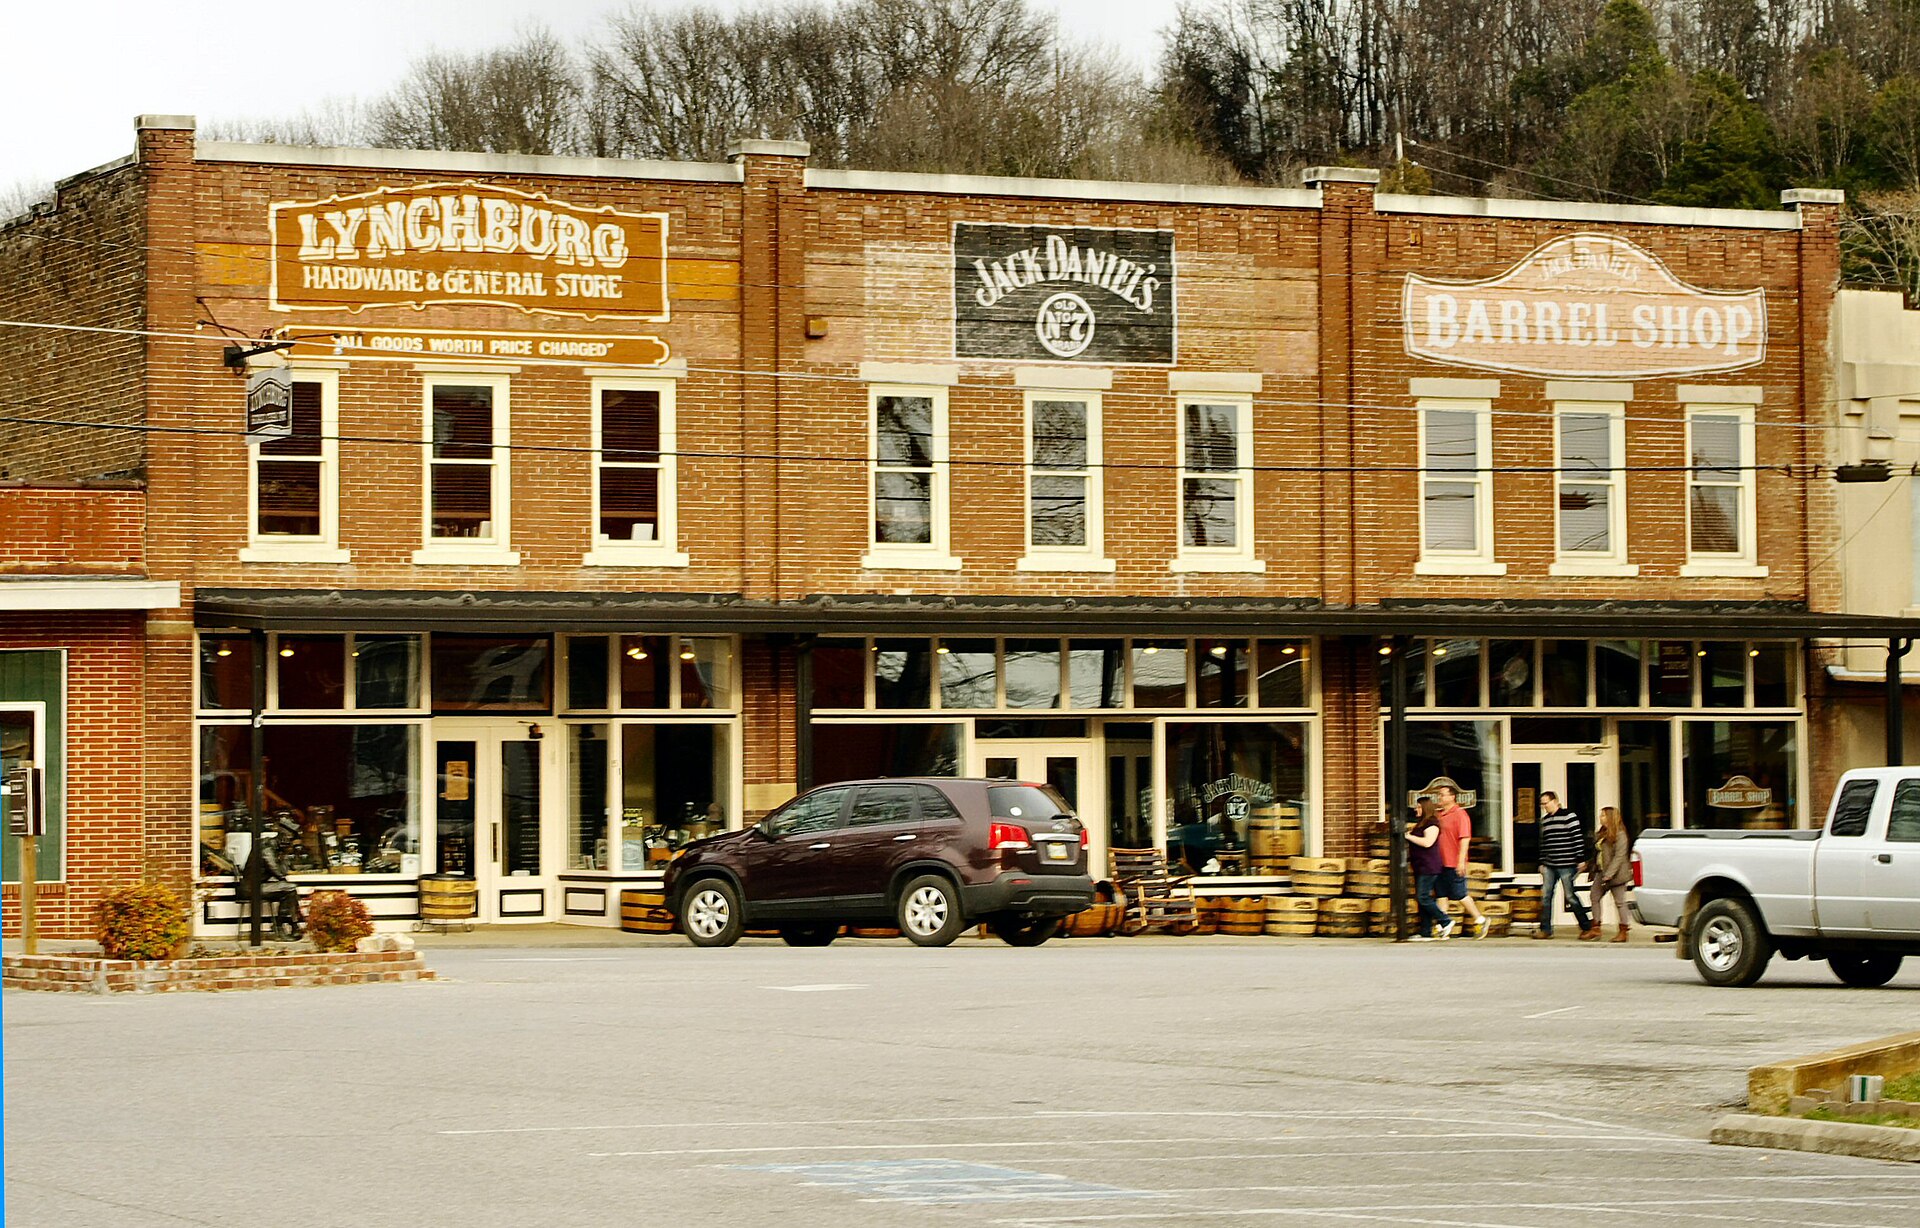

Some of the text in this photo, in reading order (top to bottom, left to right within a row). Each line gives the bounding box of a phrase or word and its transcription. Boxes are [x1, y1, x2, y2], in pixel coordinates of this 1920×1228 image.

[297, 194, 629, 269] LYNCHBURG
[303, 265, 623, 299] HARDWARE & GENERAL STORE
[969, 234, 1161, 310] JACK DANIEL'S
[1538, 254, 1575, 280] JACK
[1054, 300, 1077, 310] OLD
[1424, 293, 1753, 356] BARREL SHOP
[371, 336, 424, 352] GOODS
[428, 338, 484, 354] WORTH
[490, 340, 533, 355] PRICE
[1745, 791, 1770, 804] SHOP
